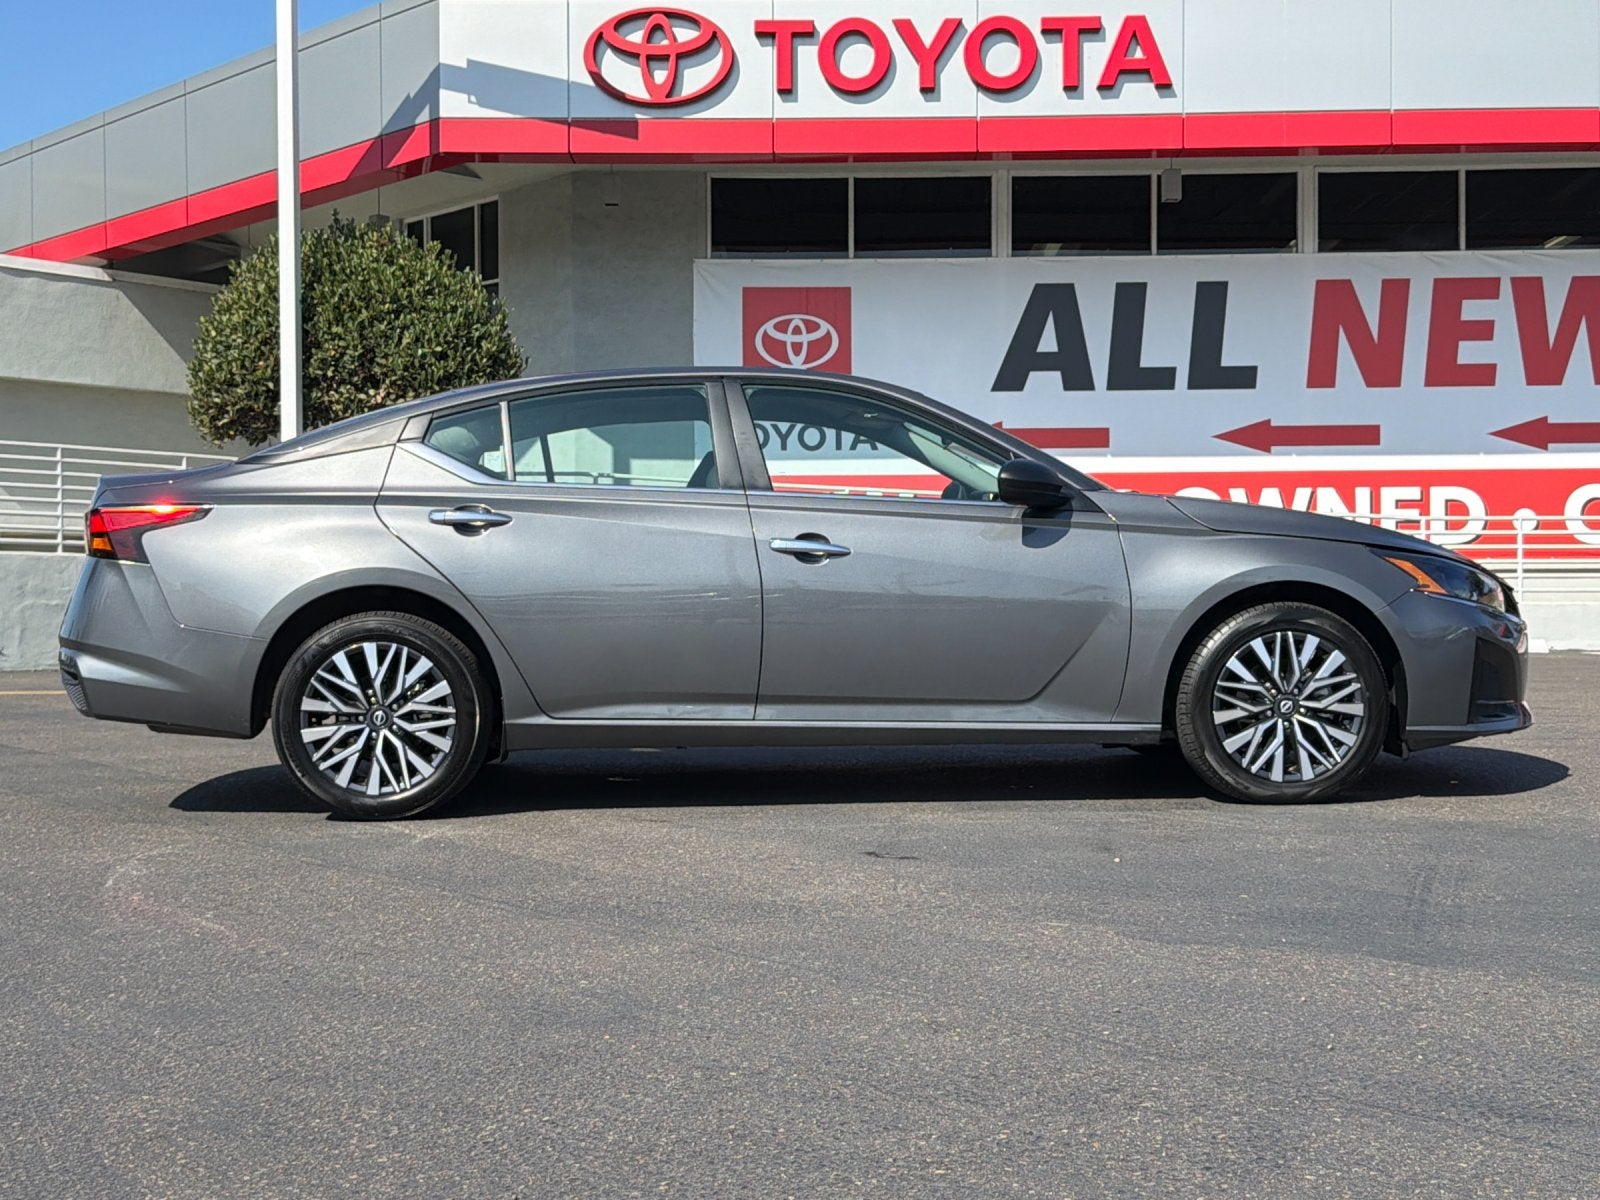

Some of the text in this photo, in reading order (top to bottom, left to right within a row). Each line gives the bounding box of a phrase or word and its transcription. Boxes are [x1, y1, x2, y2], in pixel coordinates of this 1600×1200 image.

[754, 15, 1173, 94] TOYOTA
[991, 275, 1600, 392] ALL NEW
